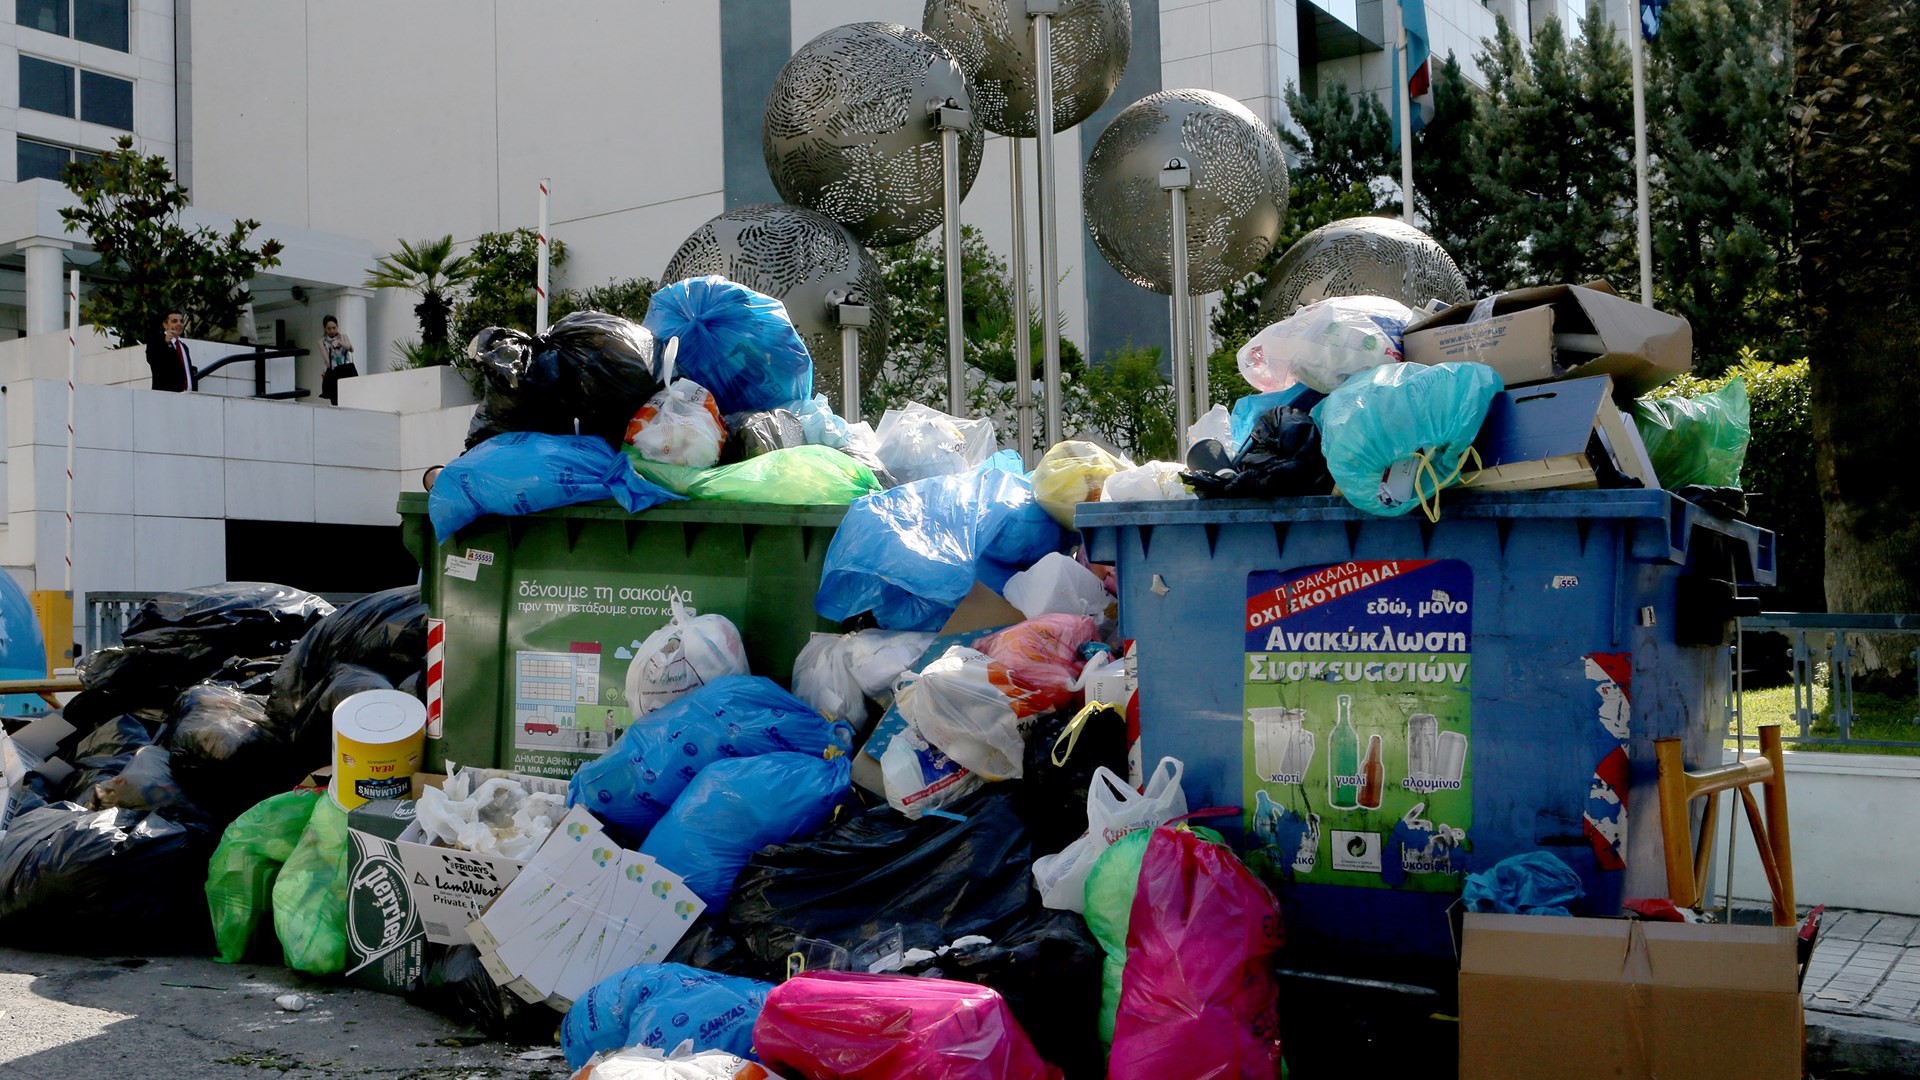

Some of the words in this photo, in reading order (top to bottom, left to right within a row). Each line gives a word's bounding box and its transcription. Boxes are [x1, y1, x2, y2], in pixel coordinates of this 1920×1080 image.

[519, 580, 588, 601] δένουμε
[593, 586, 613, 603] τη
[619, 584, 692, 603] σακούλα
[1289, 562, 1400, 613] ΣΚΟΥΠΙΔΙΑ!
[518, 601, 541, 613] πριν
[544, 604, 564, 616] την
[567, 602, 627, 617] πετάξουμε
[630, 606, 658, 616] στον
[1366, 597, 1412, 618] εδώ,
[1265, 625, 1466, 652] Ανακύκλωση
[1249, 654, 1467, 683] Συσκευασιών
[514, 754, 545, 764] ΔΗΜΟΣ
[369, 765, 395, 773] REAL
[527, 766, 541, 774] ΜΙΑ
[542, 767, 569, 776] ΑΘΗΝΑ
[1271, 773, 1300, 784] χαρτί
[1335, 774, 1367, 787] γυαλί
[1402, 776, 1461, 790] αλουμίνιο
[358, 782, 409, 797] HELLMANN'S
[699, 1004, 746, 1040] SANITAS
